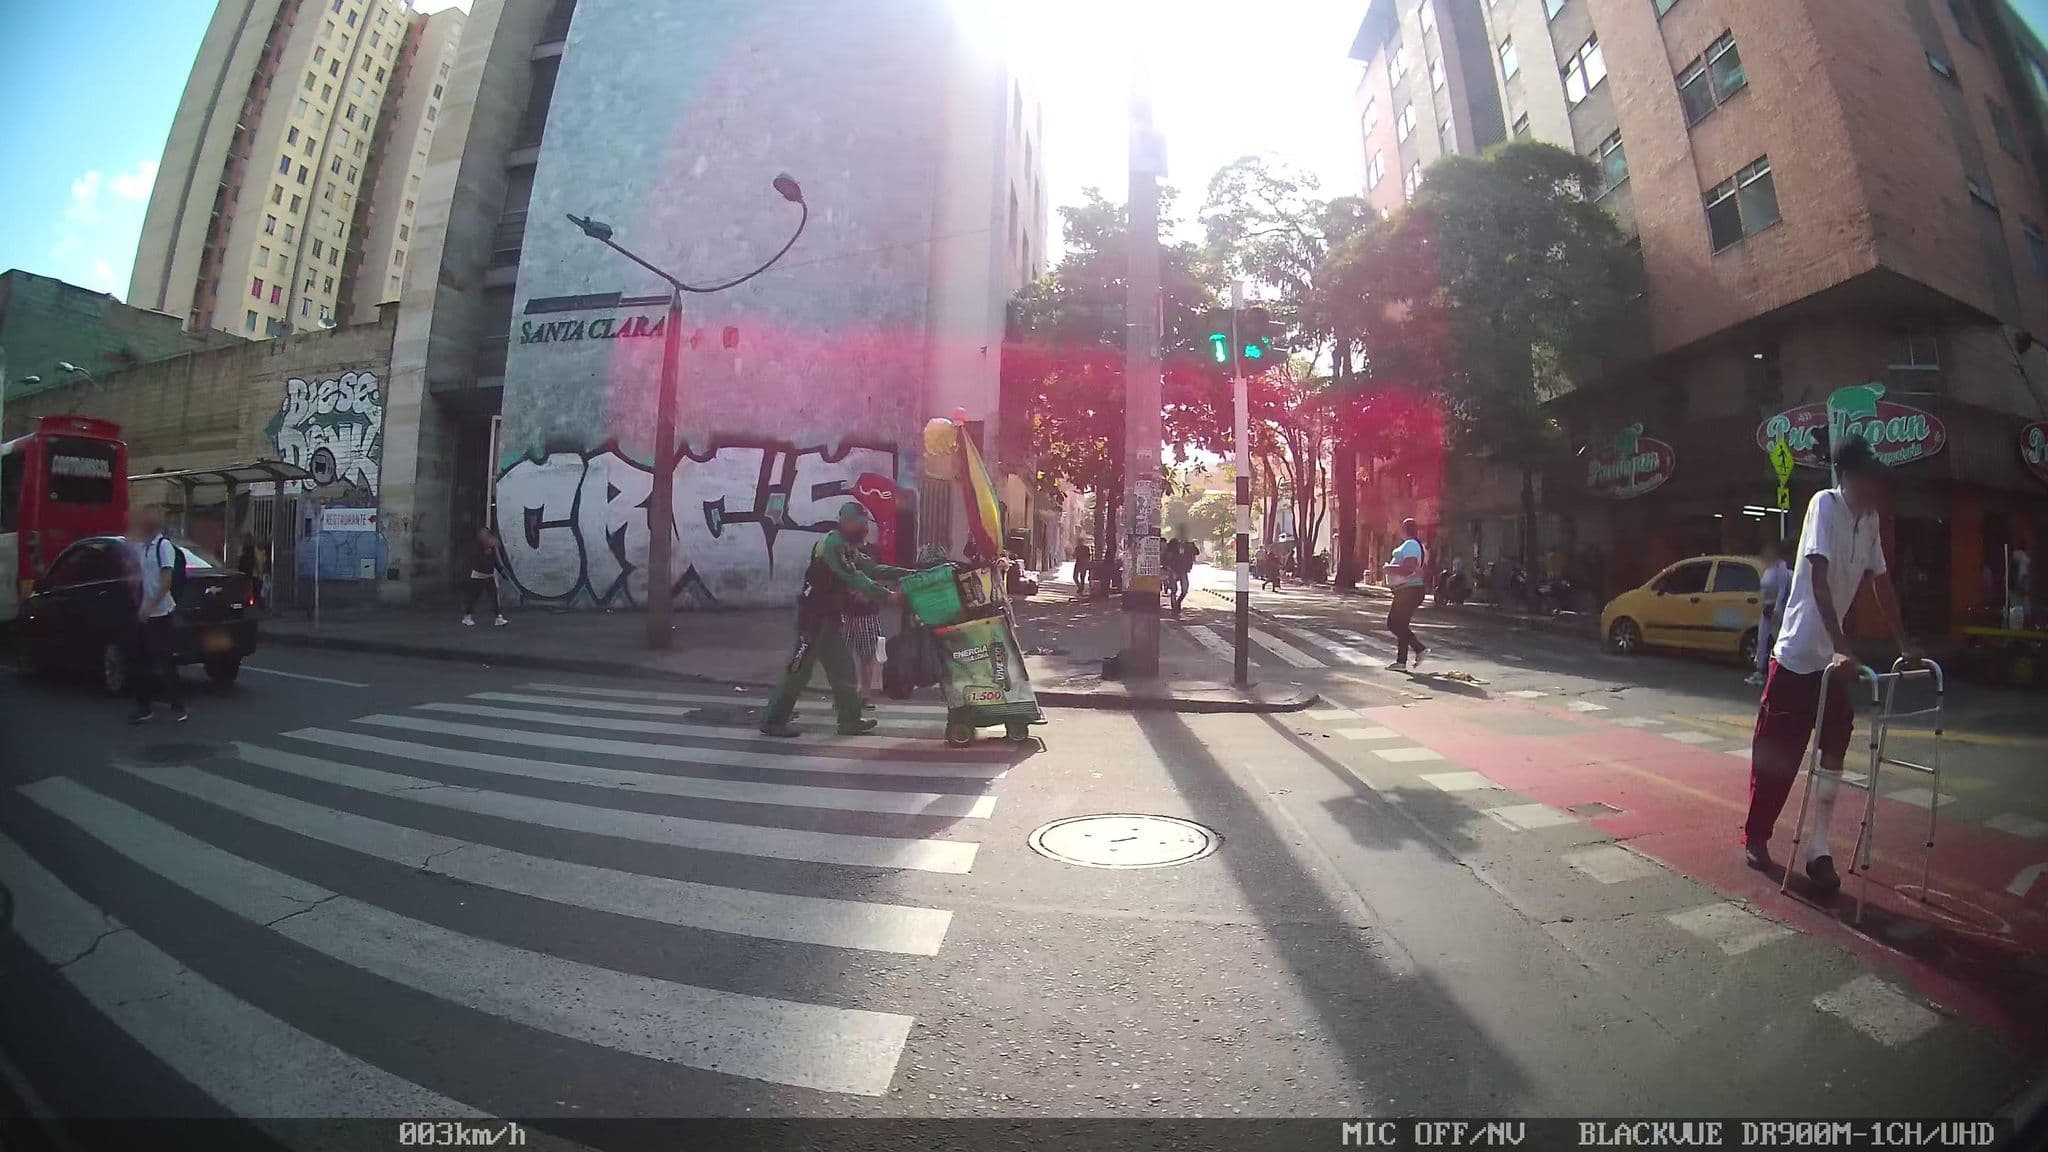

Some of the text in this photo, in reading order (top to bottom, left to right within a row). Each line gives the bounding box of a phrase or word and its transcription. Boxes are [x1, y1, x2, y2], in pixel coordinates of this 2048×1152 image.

[520, 315, 665, 345] SANTA CLARA
[859, 485, 892, 500] une
